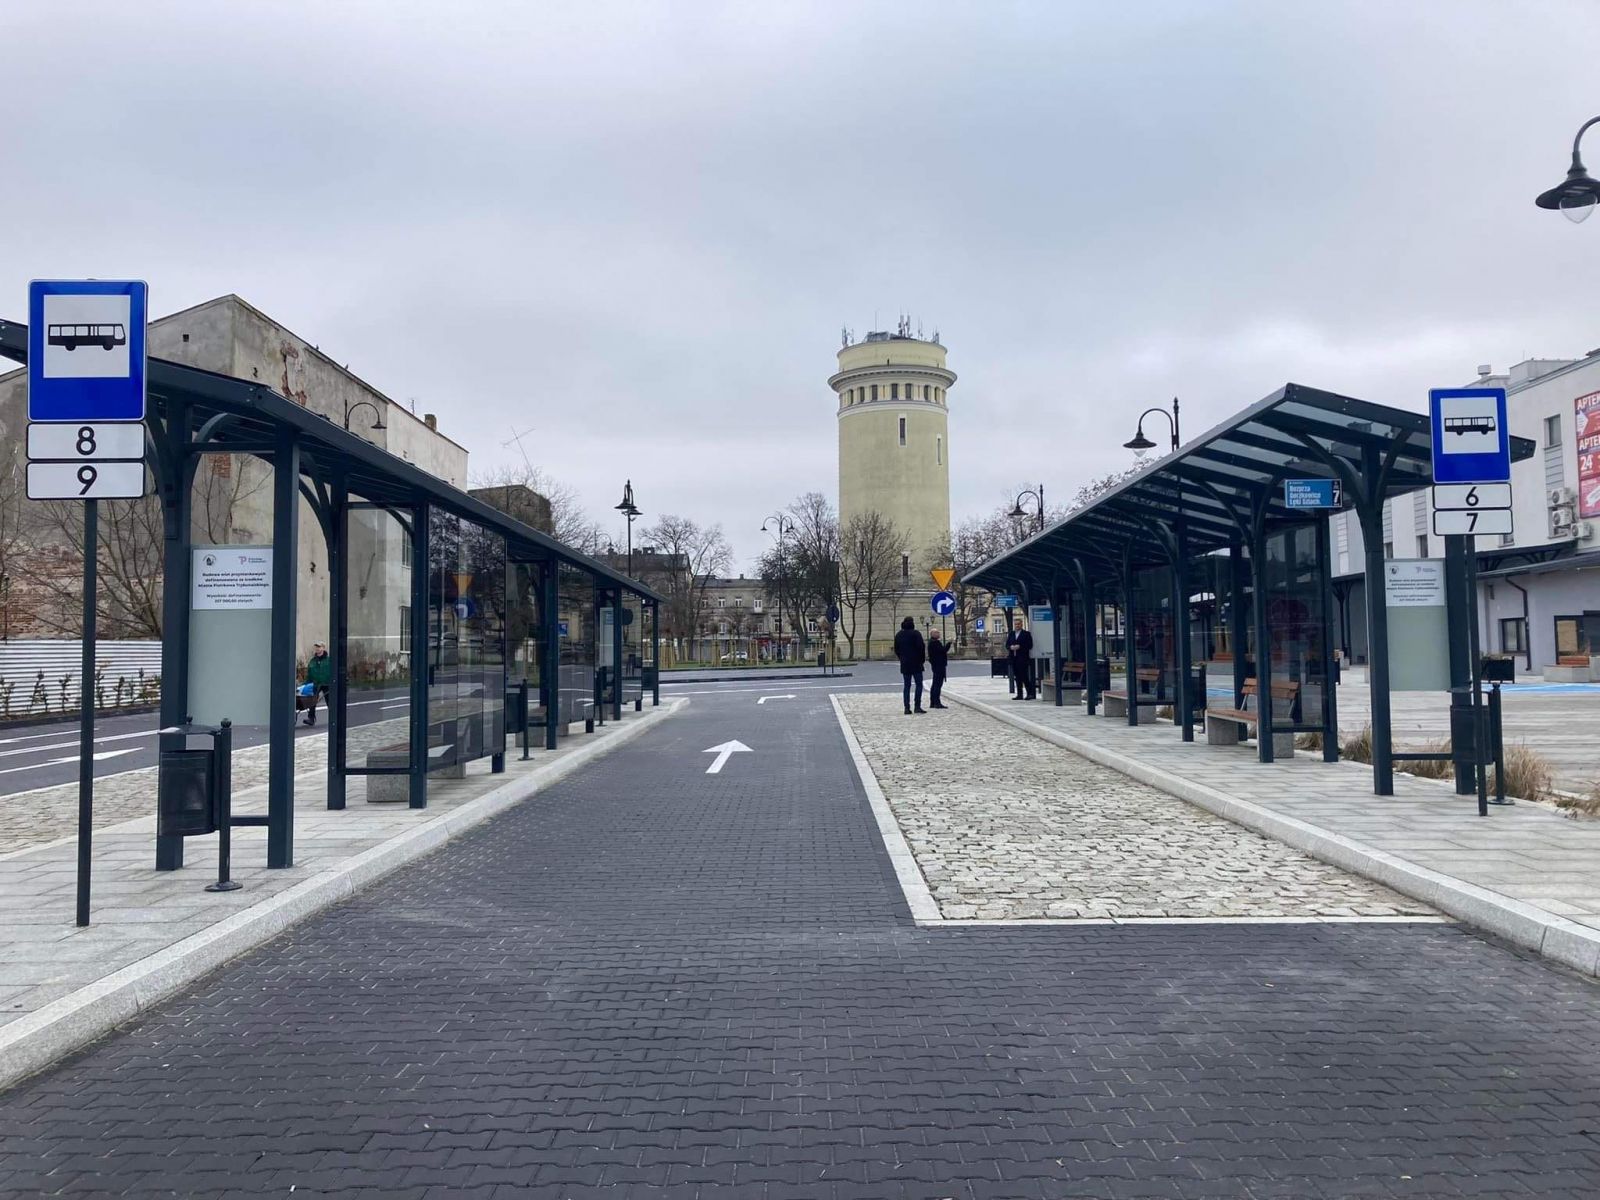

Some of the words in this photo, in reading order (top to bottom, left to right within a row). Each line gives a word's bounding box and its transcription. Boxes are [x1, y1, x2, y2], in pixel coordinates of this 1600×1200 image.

[76, 426, 96, 456] 8
[1579, 434, 1600, 450] APTE
[77, 465, 97, 496] 9
[1333, 490, 1340, 503] 7
[1466, 486, 1479, 507] 6
[1466, 512, 1479, 533] 7
